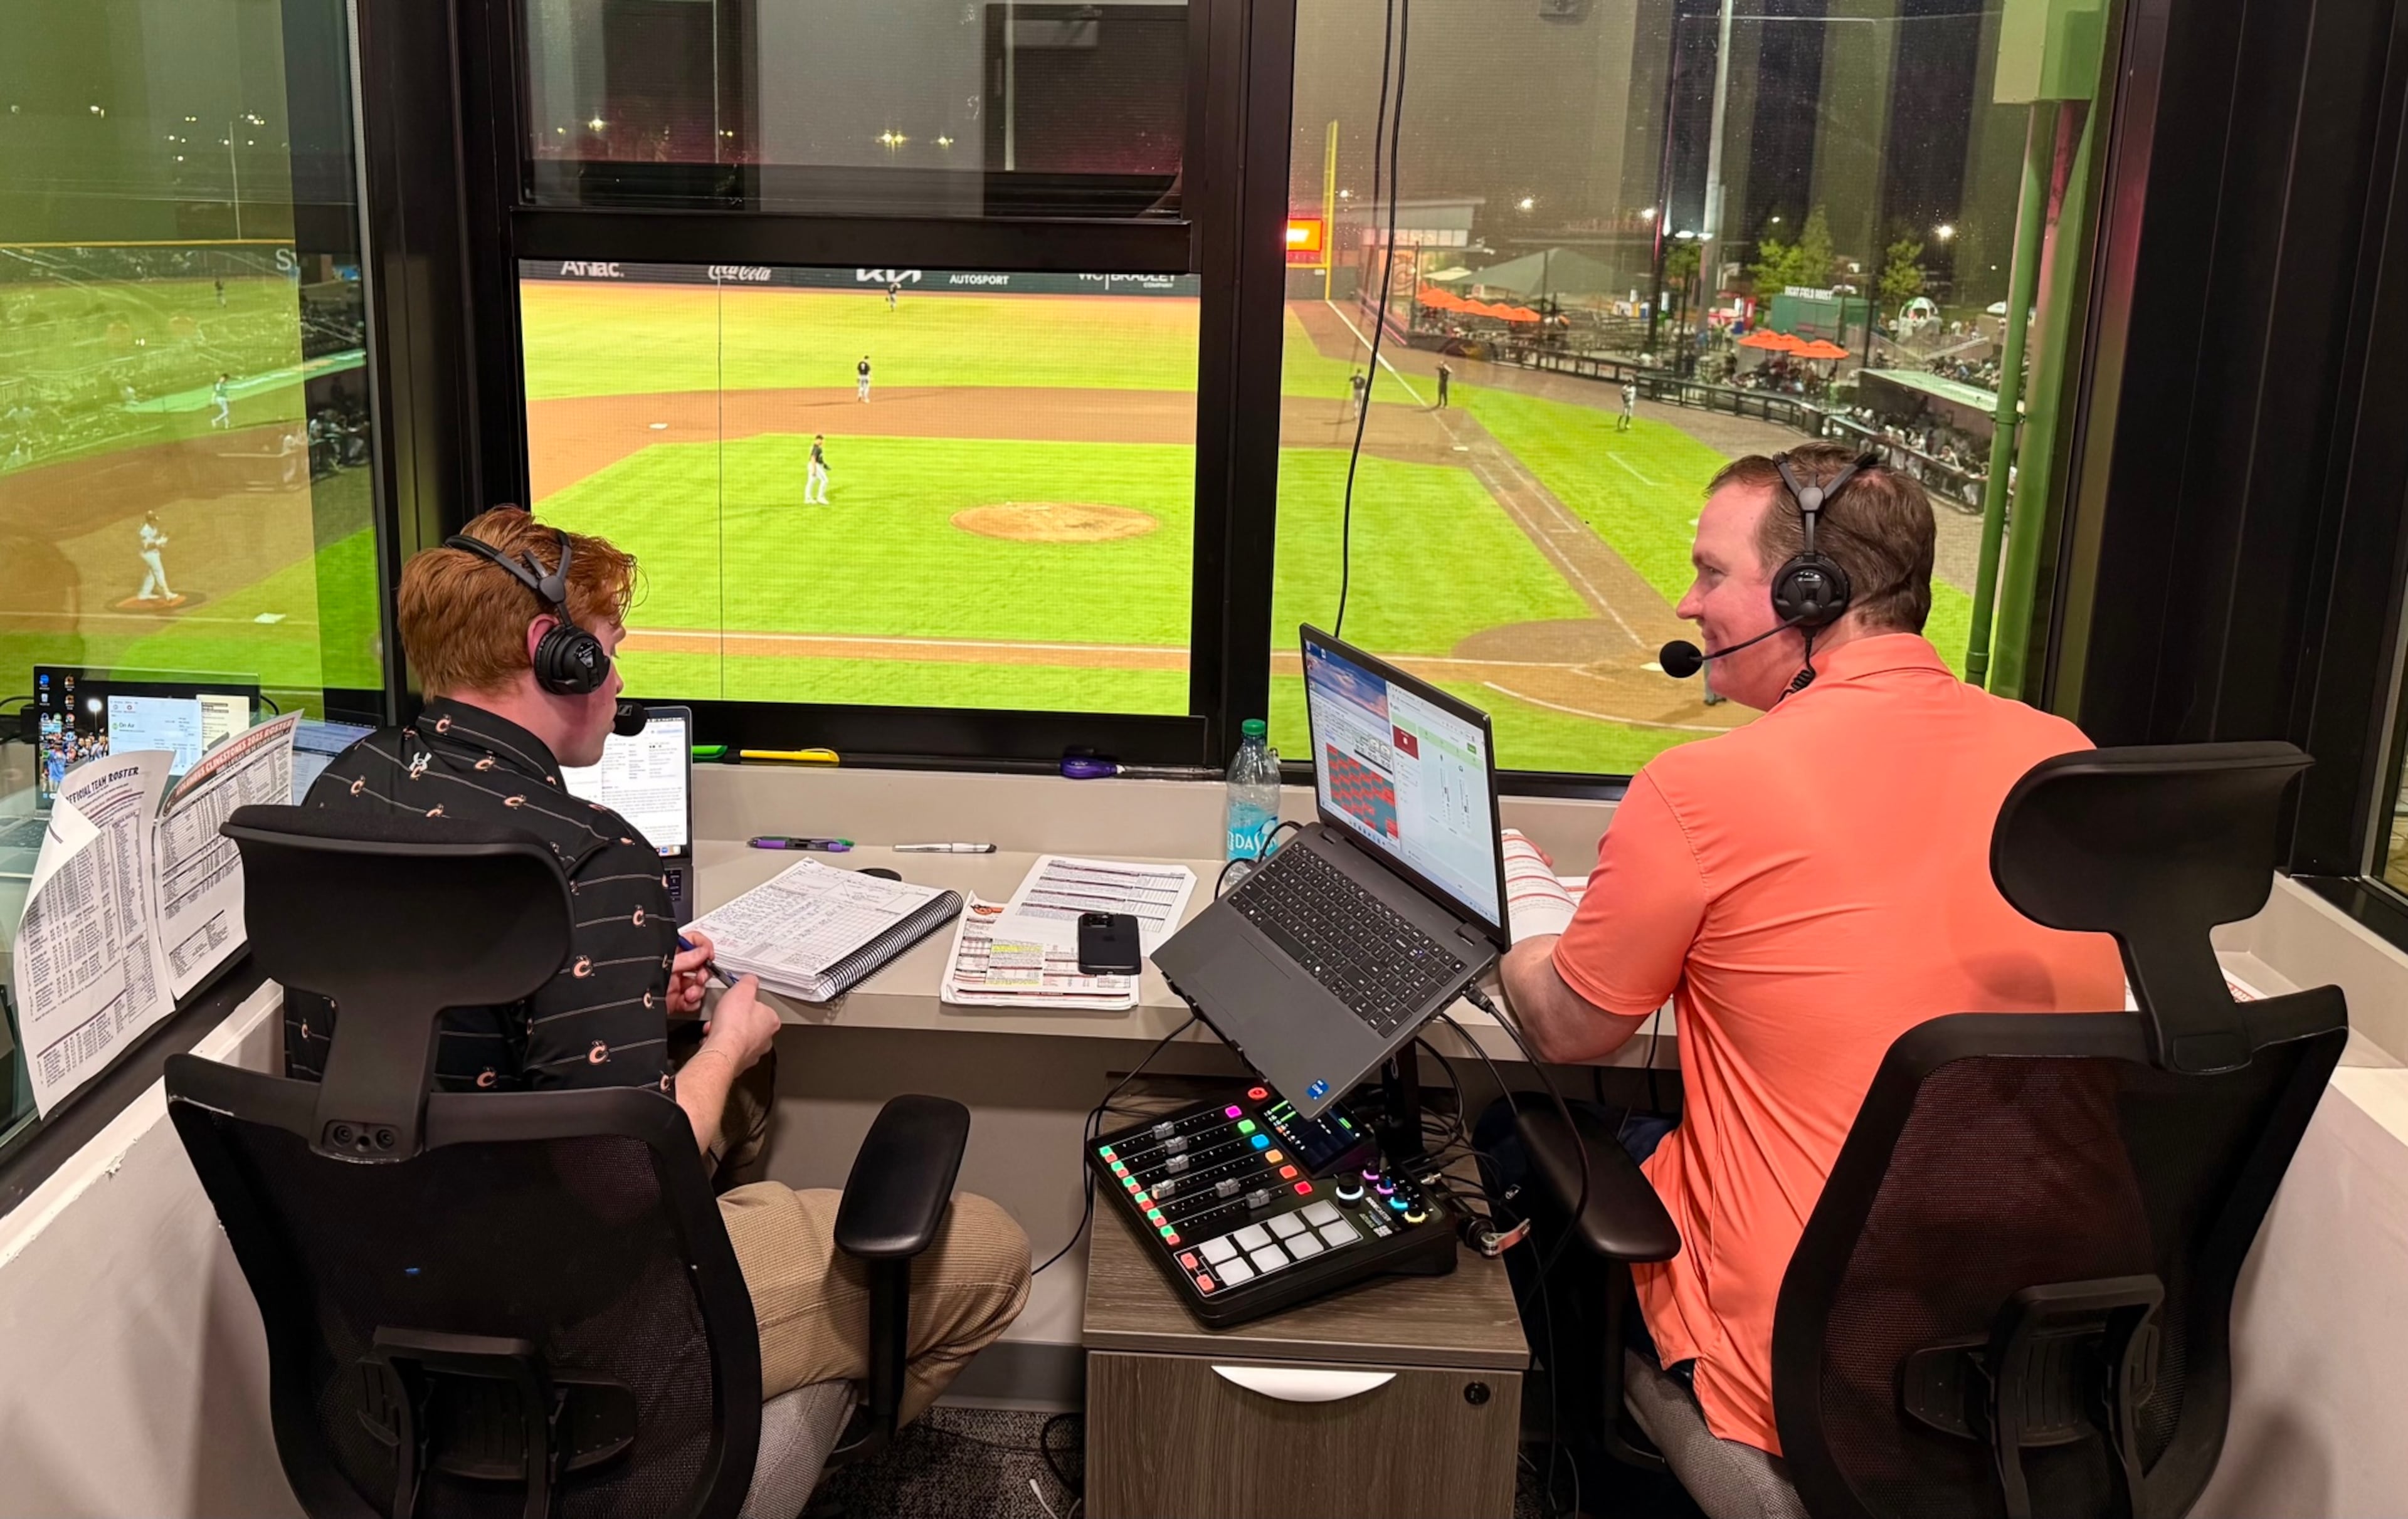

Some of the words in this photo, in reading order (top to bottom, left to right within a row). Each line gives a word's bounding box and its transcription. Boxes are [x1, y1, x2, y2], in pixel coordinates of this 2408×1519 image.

[949, 274, 1010, 285] AUTOSPORT
[247, 730, 264, 748] 2025
[263, 718, 293, 738] ROSTER
[91, 775, 107, 792] TEAM
[108, 767, 139, 782] ROSTER
